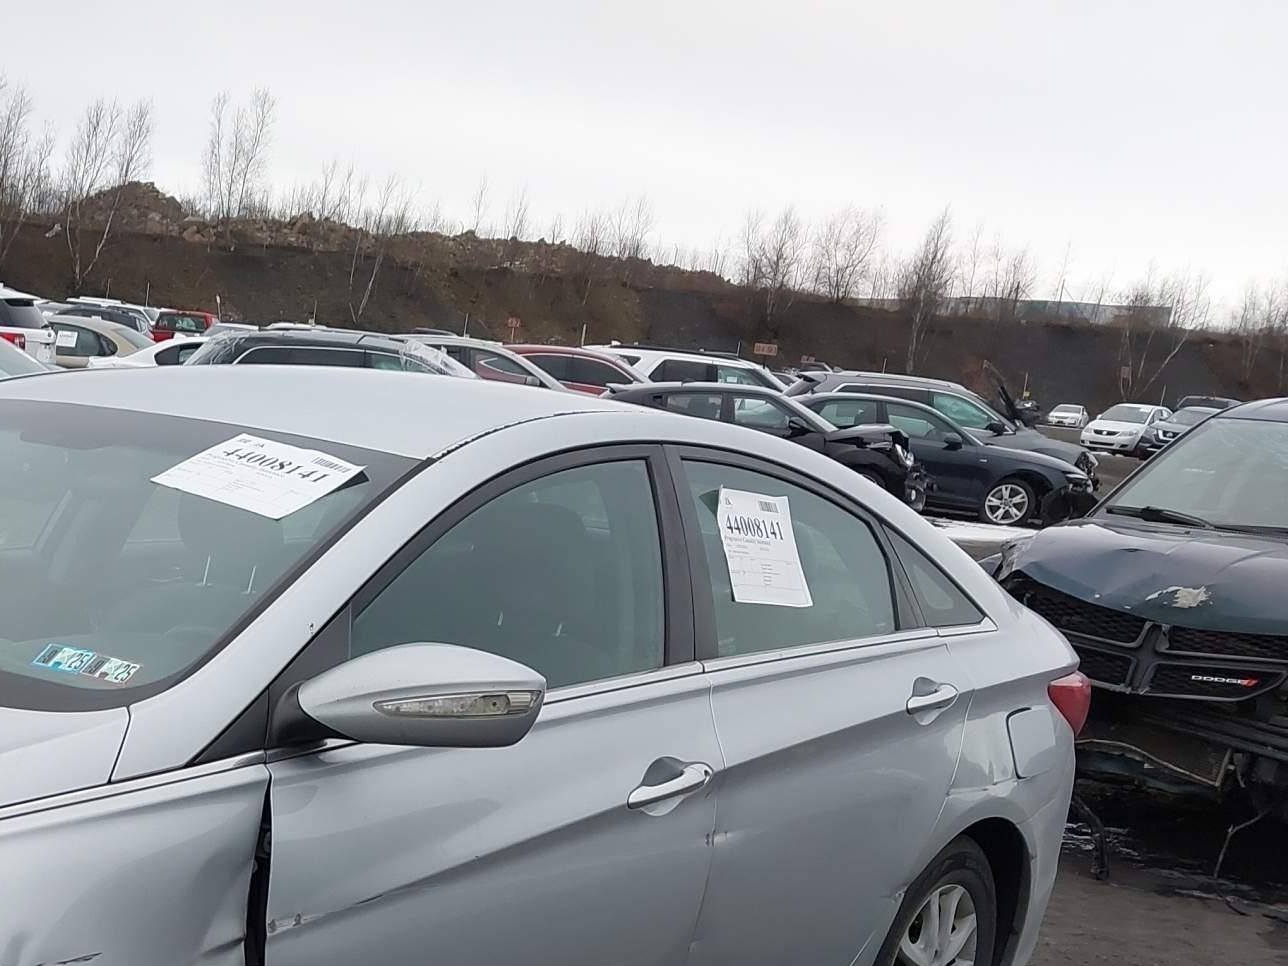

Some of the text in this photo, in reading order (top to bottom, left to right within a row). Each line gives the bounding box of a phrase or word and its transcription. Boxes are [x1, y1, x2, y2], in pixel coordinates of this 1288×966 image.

[223, 447, 330, 483] 44008141
[725, 514, 784, 541] 44008141
[1191, 675, 1245, 684] DODGE
